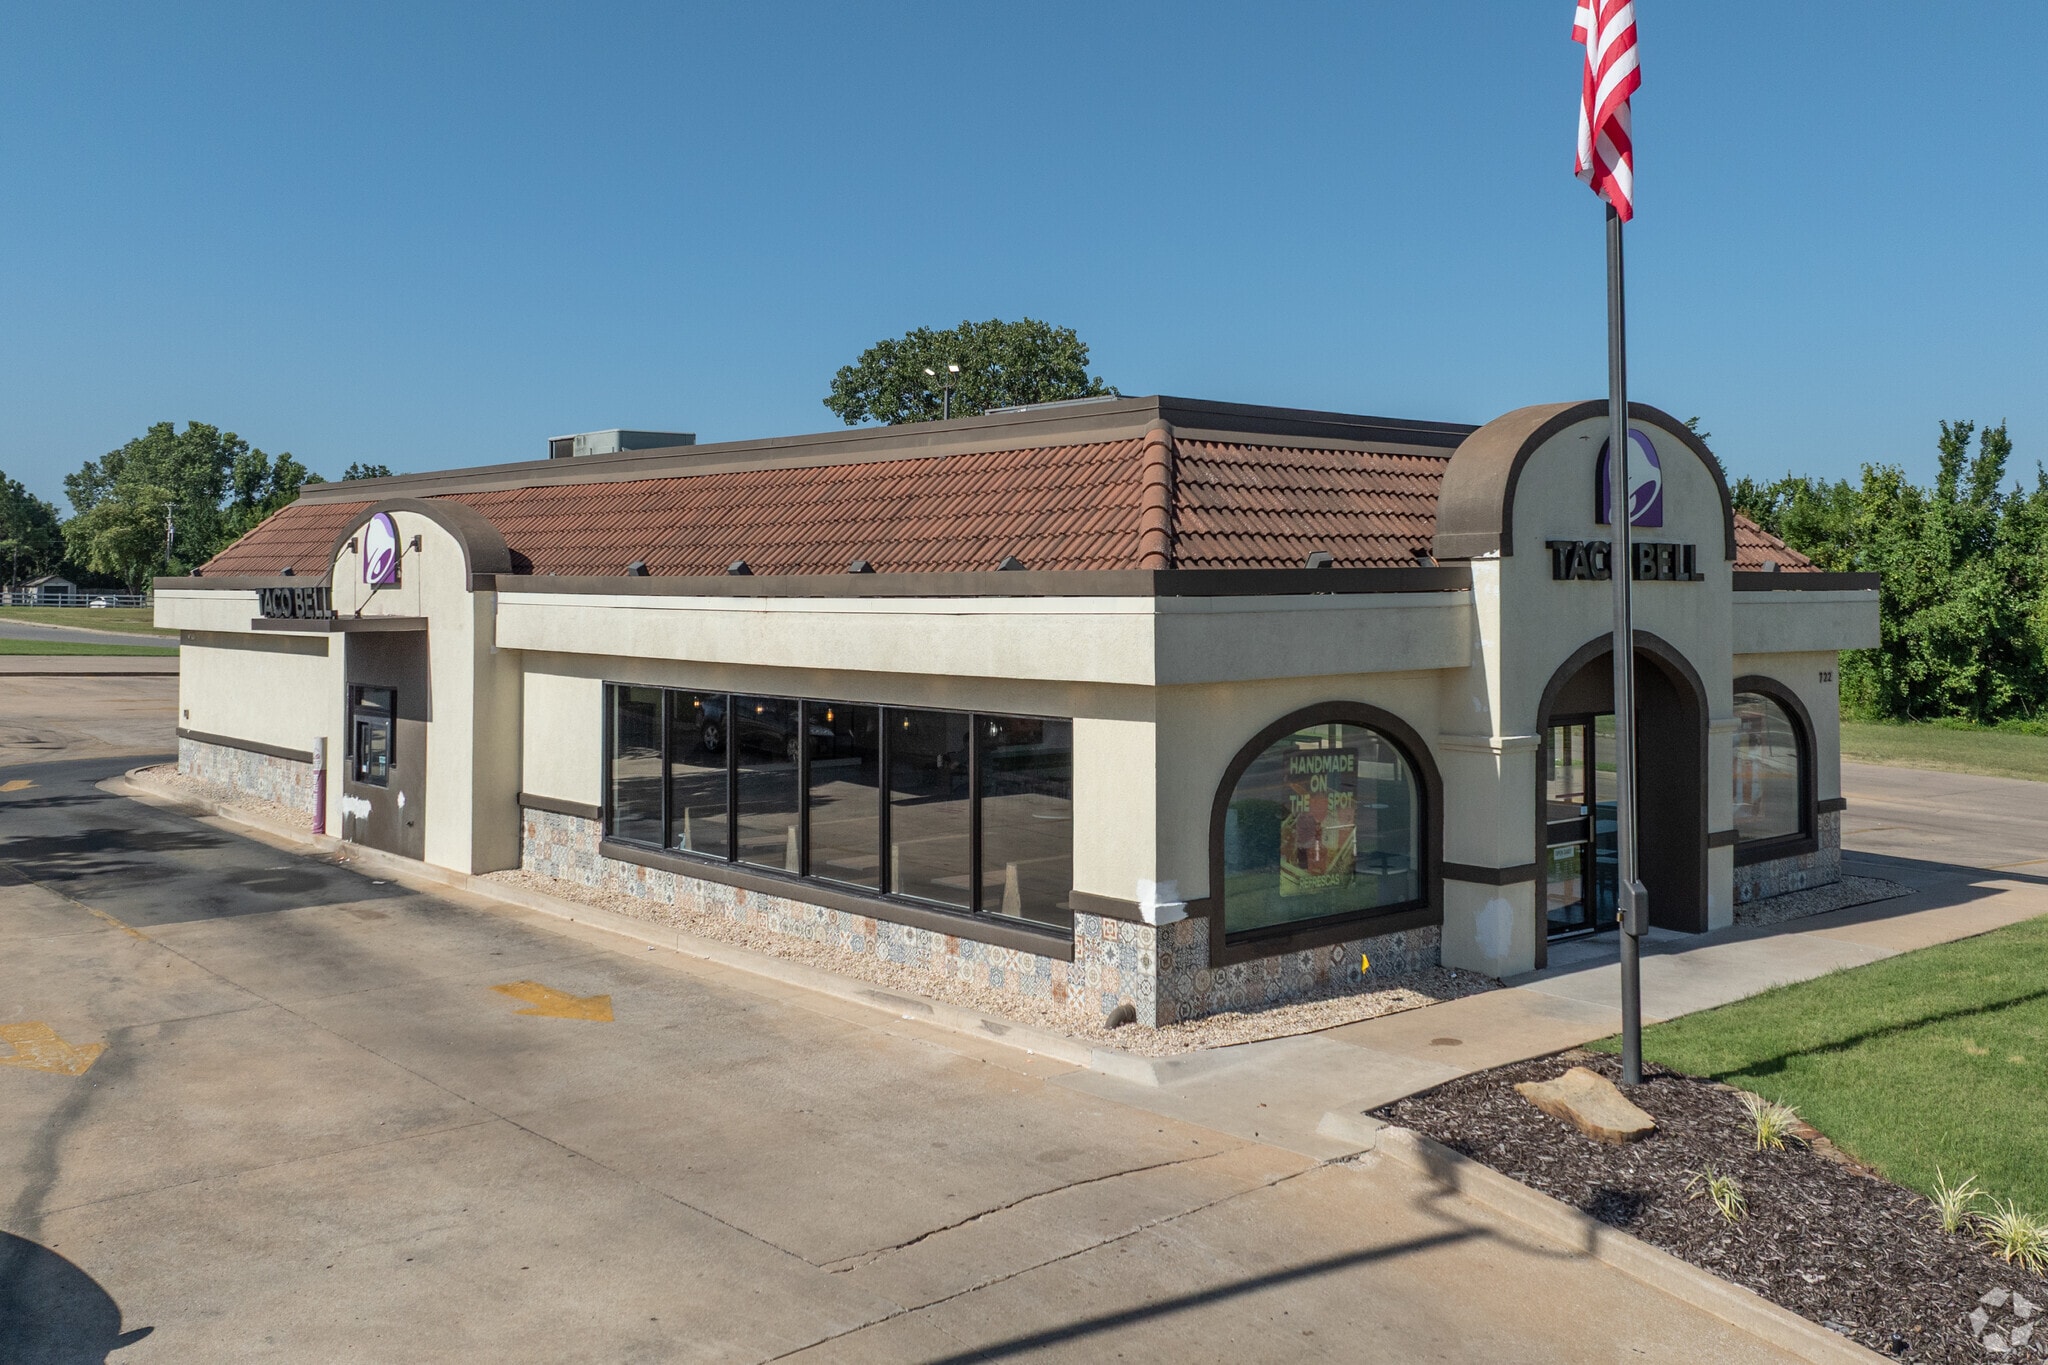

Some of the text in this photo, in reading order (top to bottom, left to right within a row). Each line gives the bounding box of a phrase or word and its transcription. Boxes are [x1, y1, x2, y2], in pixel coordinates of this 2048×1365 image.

[1546, 540, 1704, 581] TAC BELL
[256, 588, 335, 619] TACO BELL
[1290, 755, 1354, 774] HANDMADE
[1310, 776, 1327, 792] ON
[1290, 792, 1353, 813] THE SPOT
